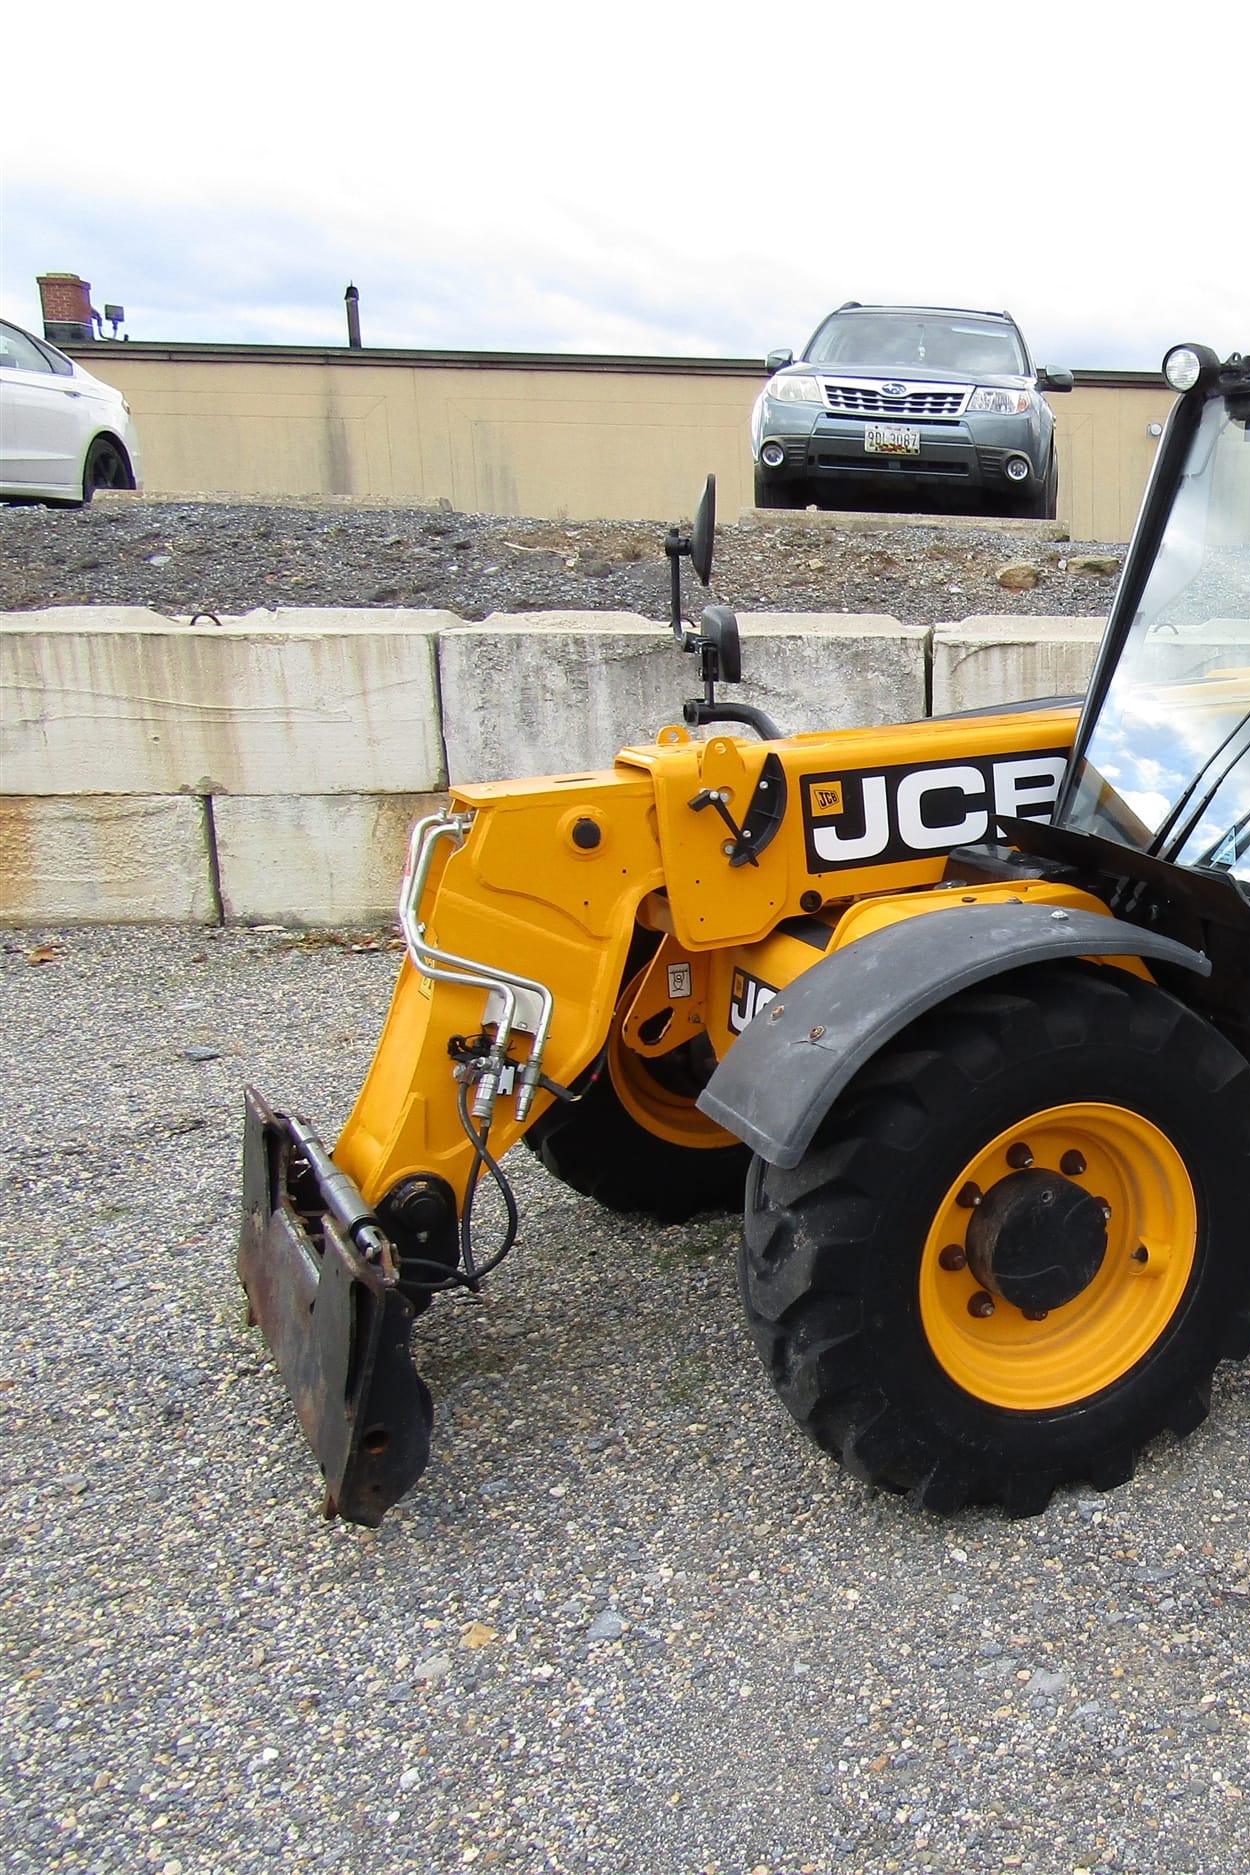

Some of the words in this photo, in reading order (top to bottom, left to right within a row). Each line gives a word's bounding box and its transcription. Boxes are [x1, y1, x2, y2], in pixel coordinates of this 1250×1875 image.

[812, 756, 1068, 862] JCB
[819, 791, 838, 807] JCB
[731, 980, 777, 1032] JC
